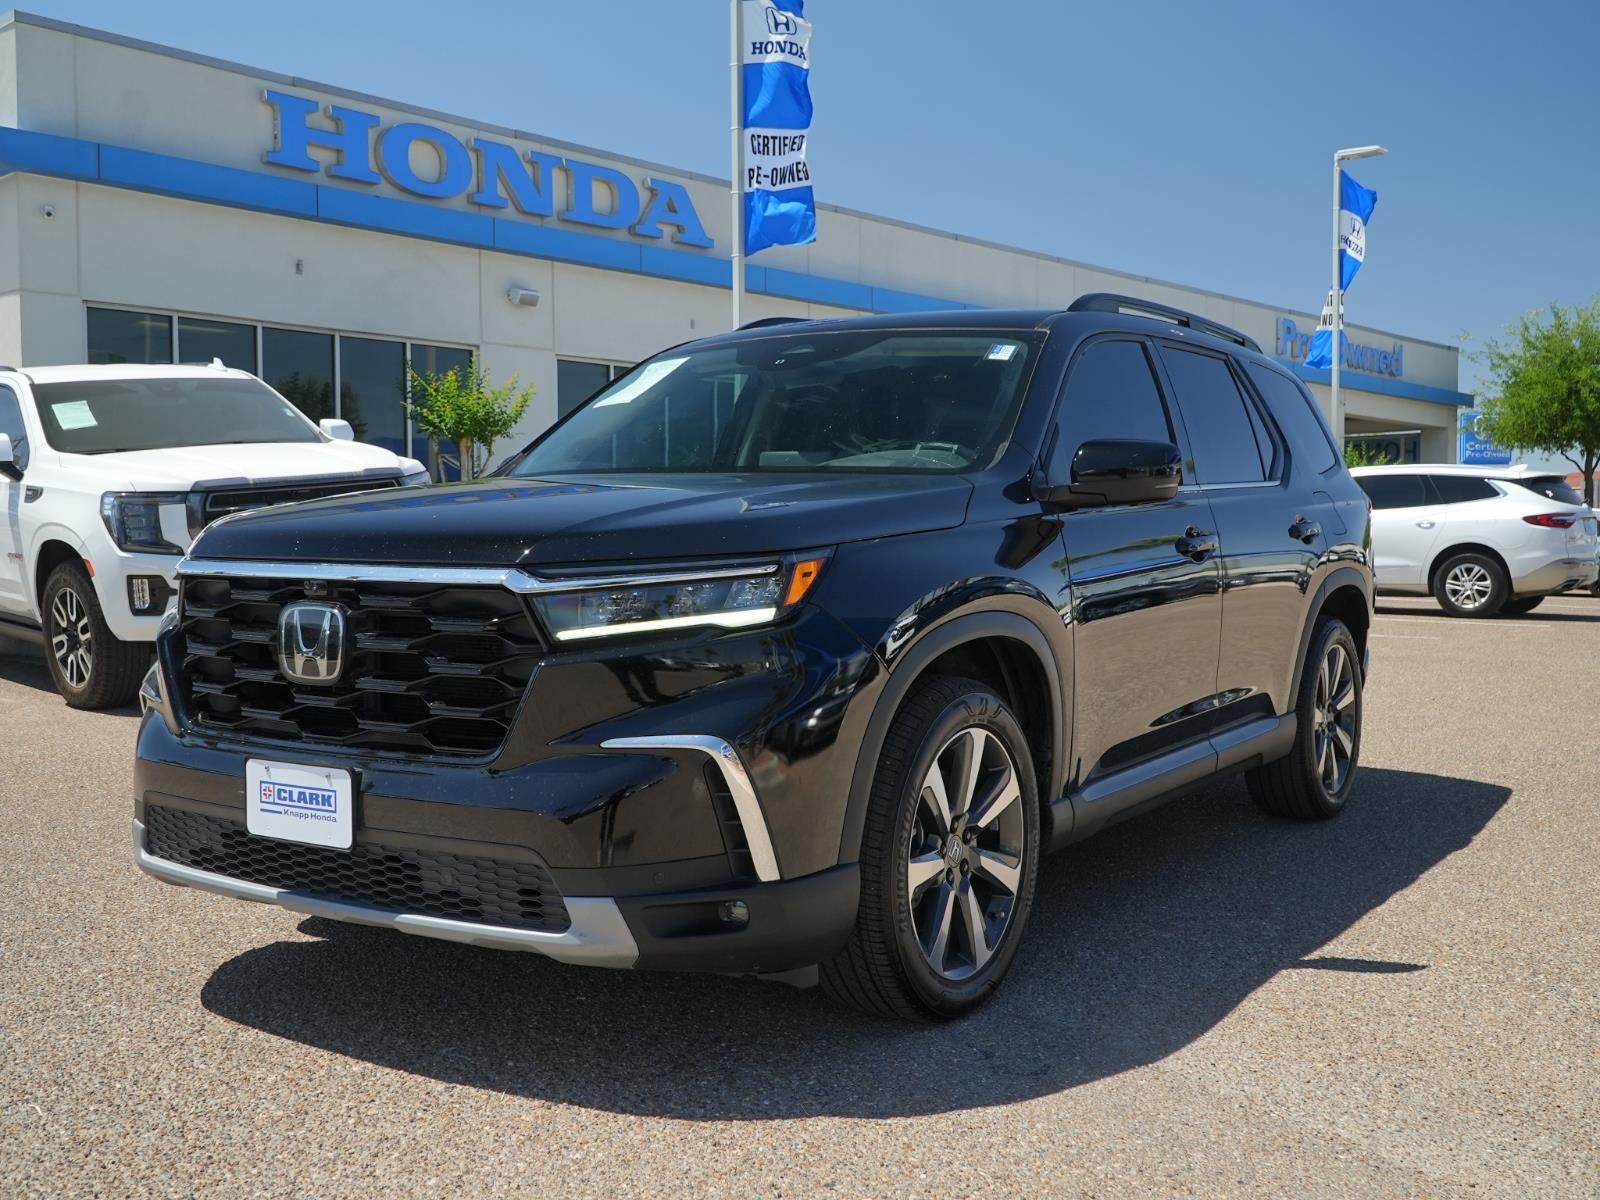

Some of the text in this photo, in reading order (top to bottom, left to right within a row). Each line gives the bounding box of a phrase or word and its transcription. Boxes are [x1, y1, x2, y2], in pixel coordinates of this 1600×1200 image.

[751, 41, 807, 61] HONDA
[750, 134, 805, 156] CERTIFIED
[264, 89, 715, 249] HONDA
[748, 161, 809, 188] PE-OWNED
[276, 788, 333, 808] CLARK
[283, 808, 337, 823] Knapp Honda
